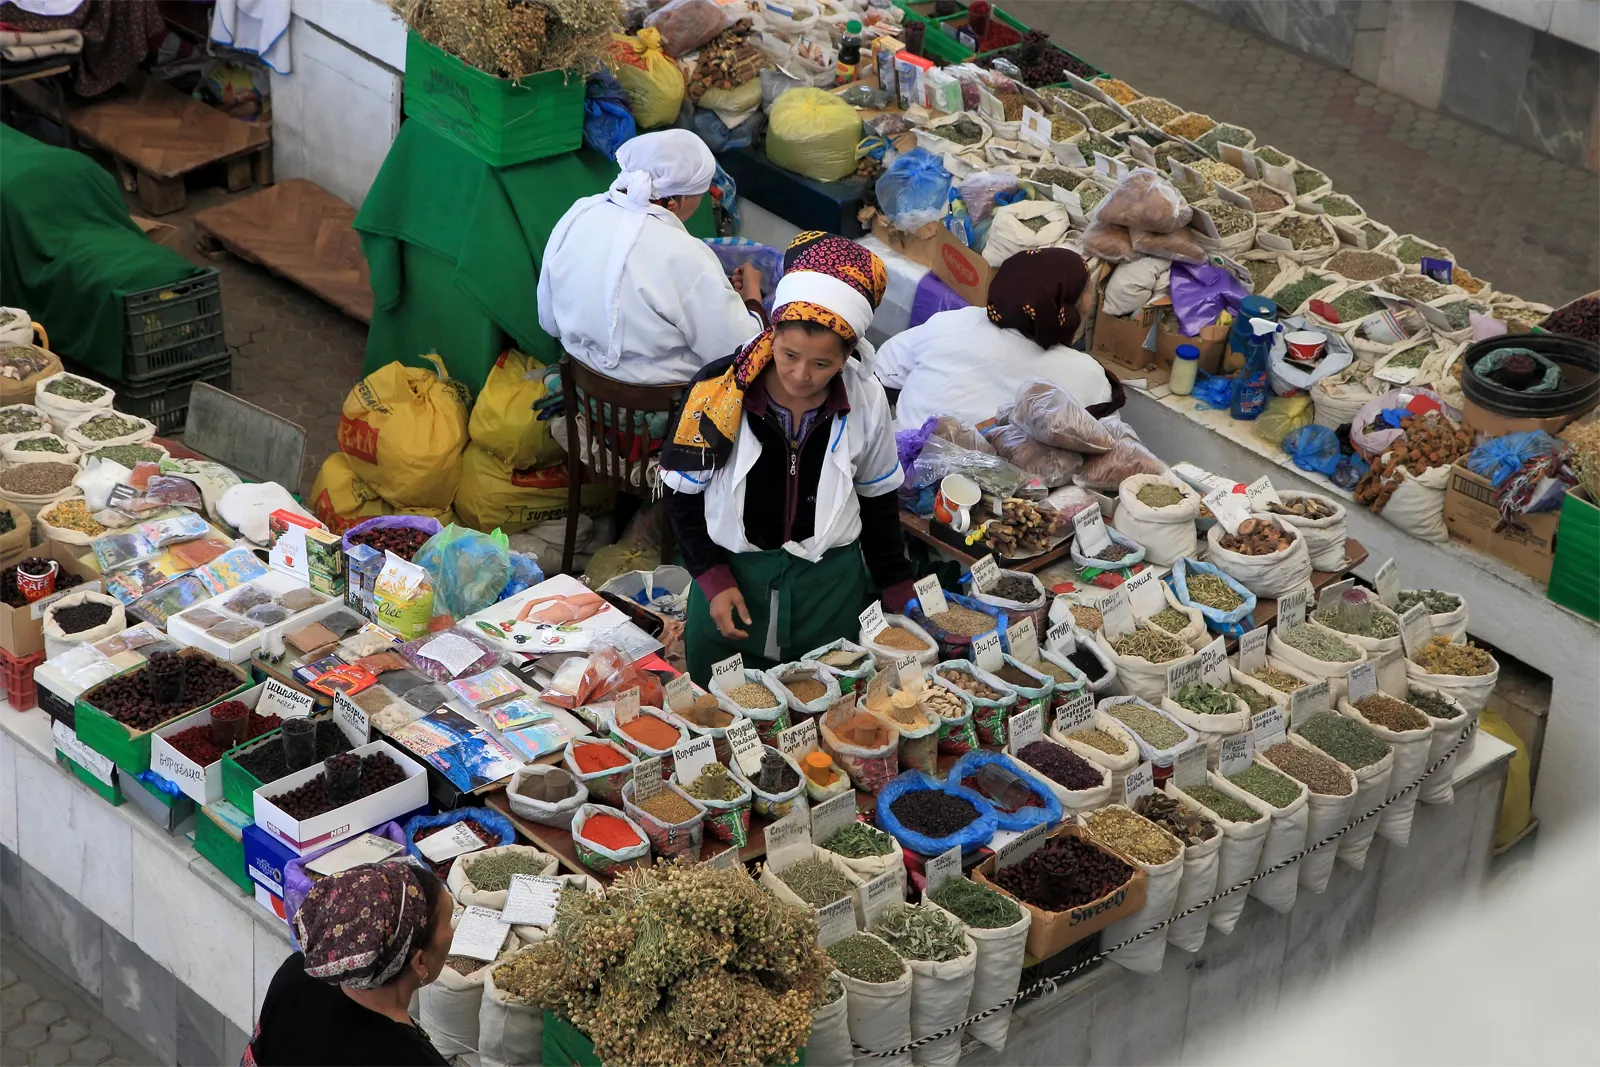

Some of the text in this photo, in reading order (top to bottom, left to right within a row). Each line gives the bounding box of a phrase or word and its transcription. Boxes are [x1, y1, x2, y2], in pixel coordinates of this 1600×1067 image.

[975, 635, 998, 655] Зира
[715, 657, 742, 675] Кинза
[331, 824, 349, 837] NBB
[1069, 887, 1128, 927] Sweety
